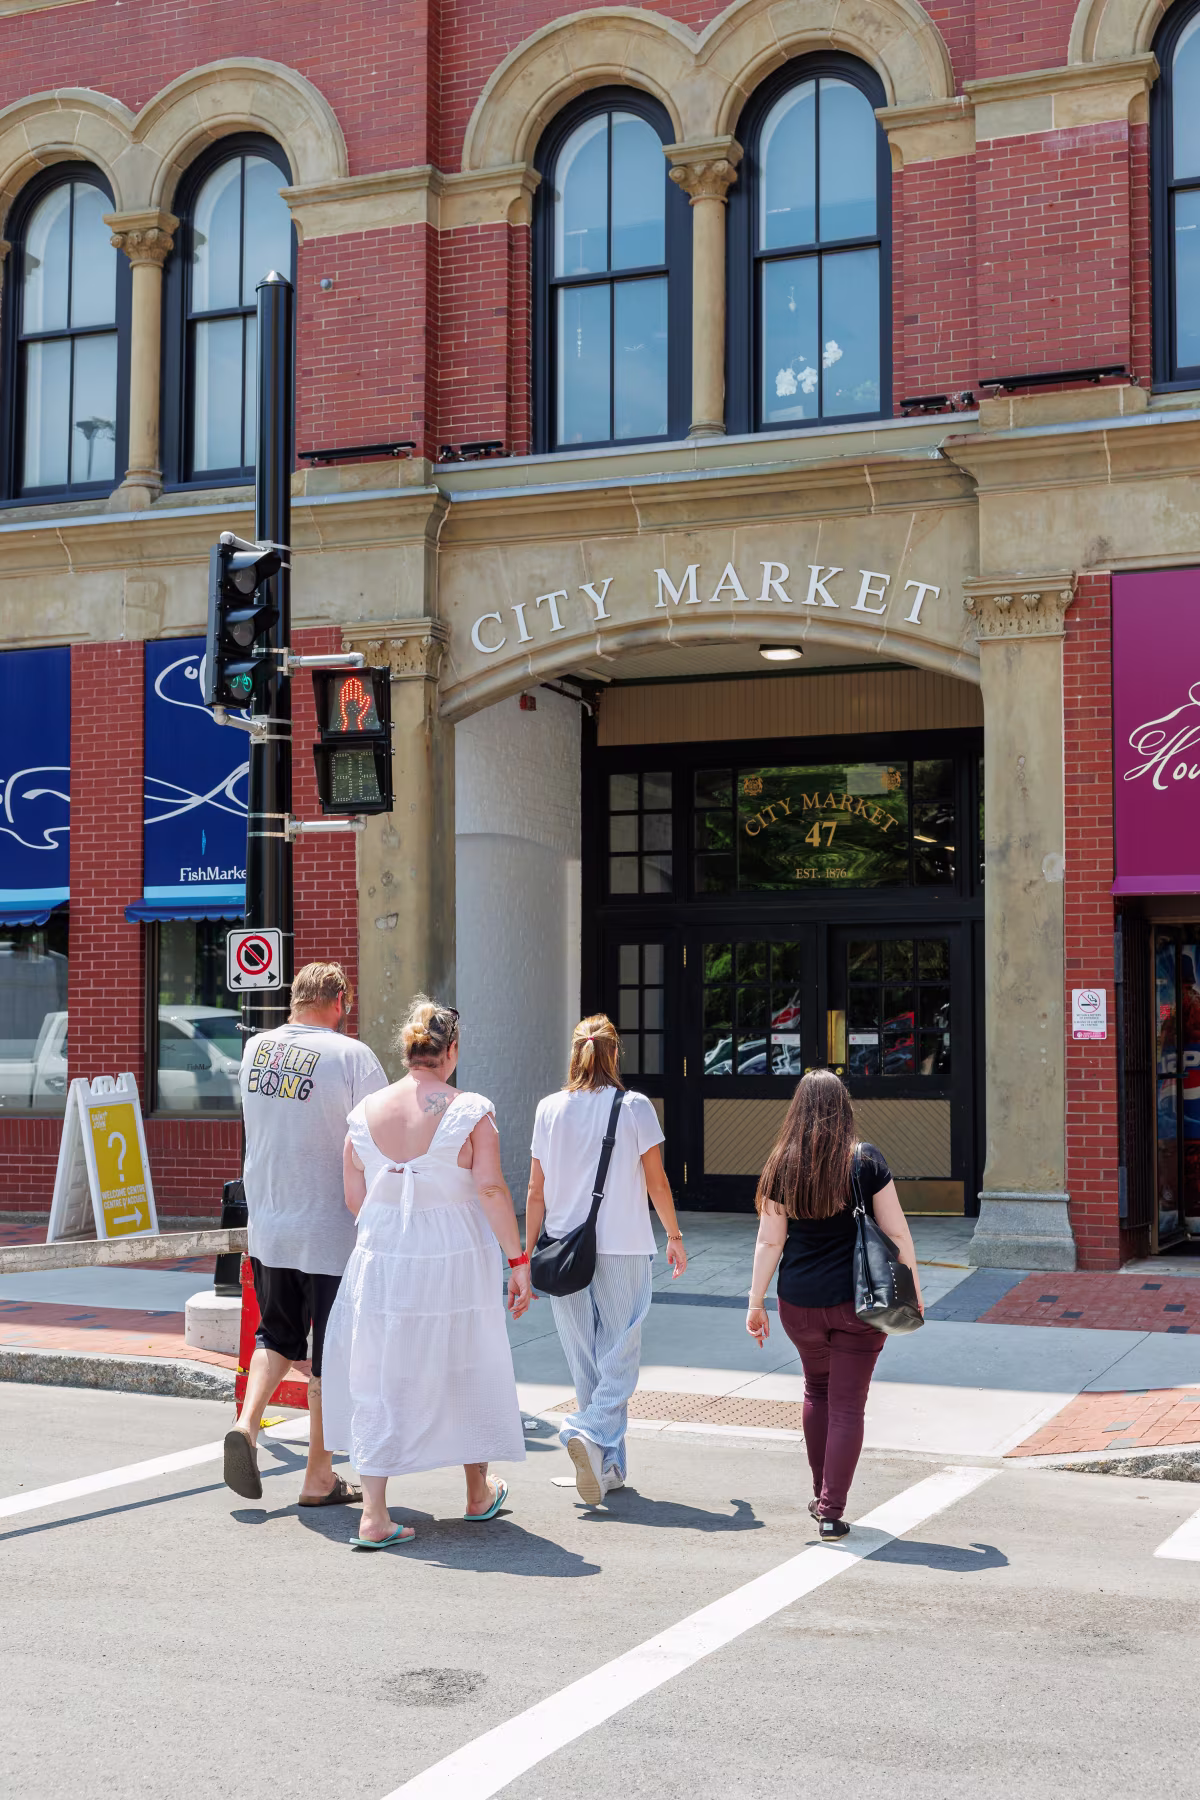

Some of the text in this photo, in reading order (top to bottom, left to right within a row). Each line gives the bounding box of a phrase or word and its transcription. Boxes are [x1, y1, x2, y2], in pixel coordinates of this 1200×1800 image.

[471, 561, 941, 655] CITY MARKET
[745, 791, 899, 837] CITY MARKET
[804, 821, 838, 847] 47
[179, 865, 246, 882] FishMarke
[795, 867, 847, 879] EST. 1876
[107, 1131, 127, 1183] ?
[101, 1184, 145, 1200] WELCOME CENTRE
[103, 1199, 123, 1209] CENTRE
